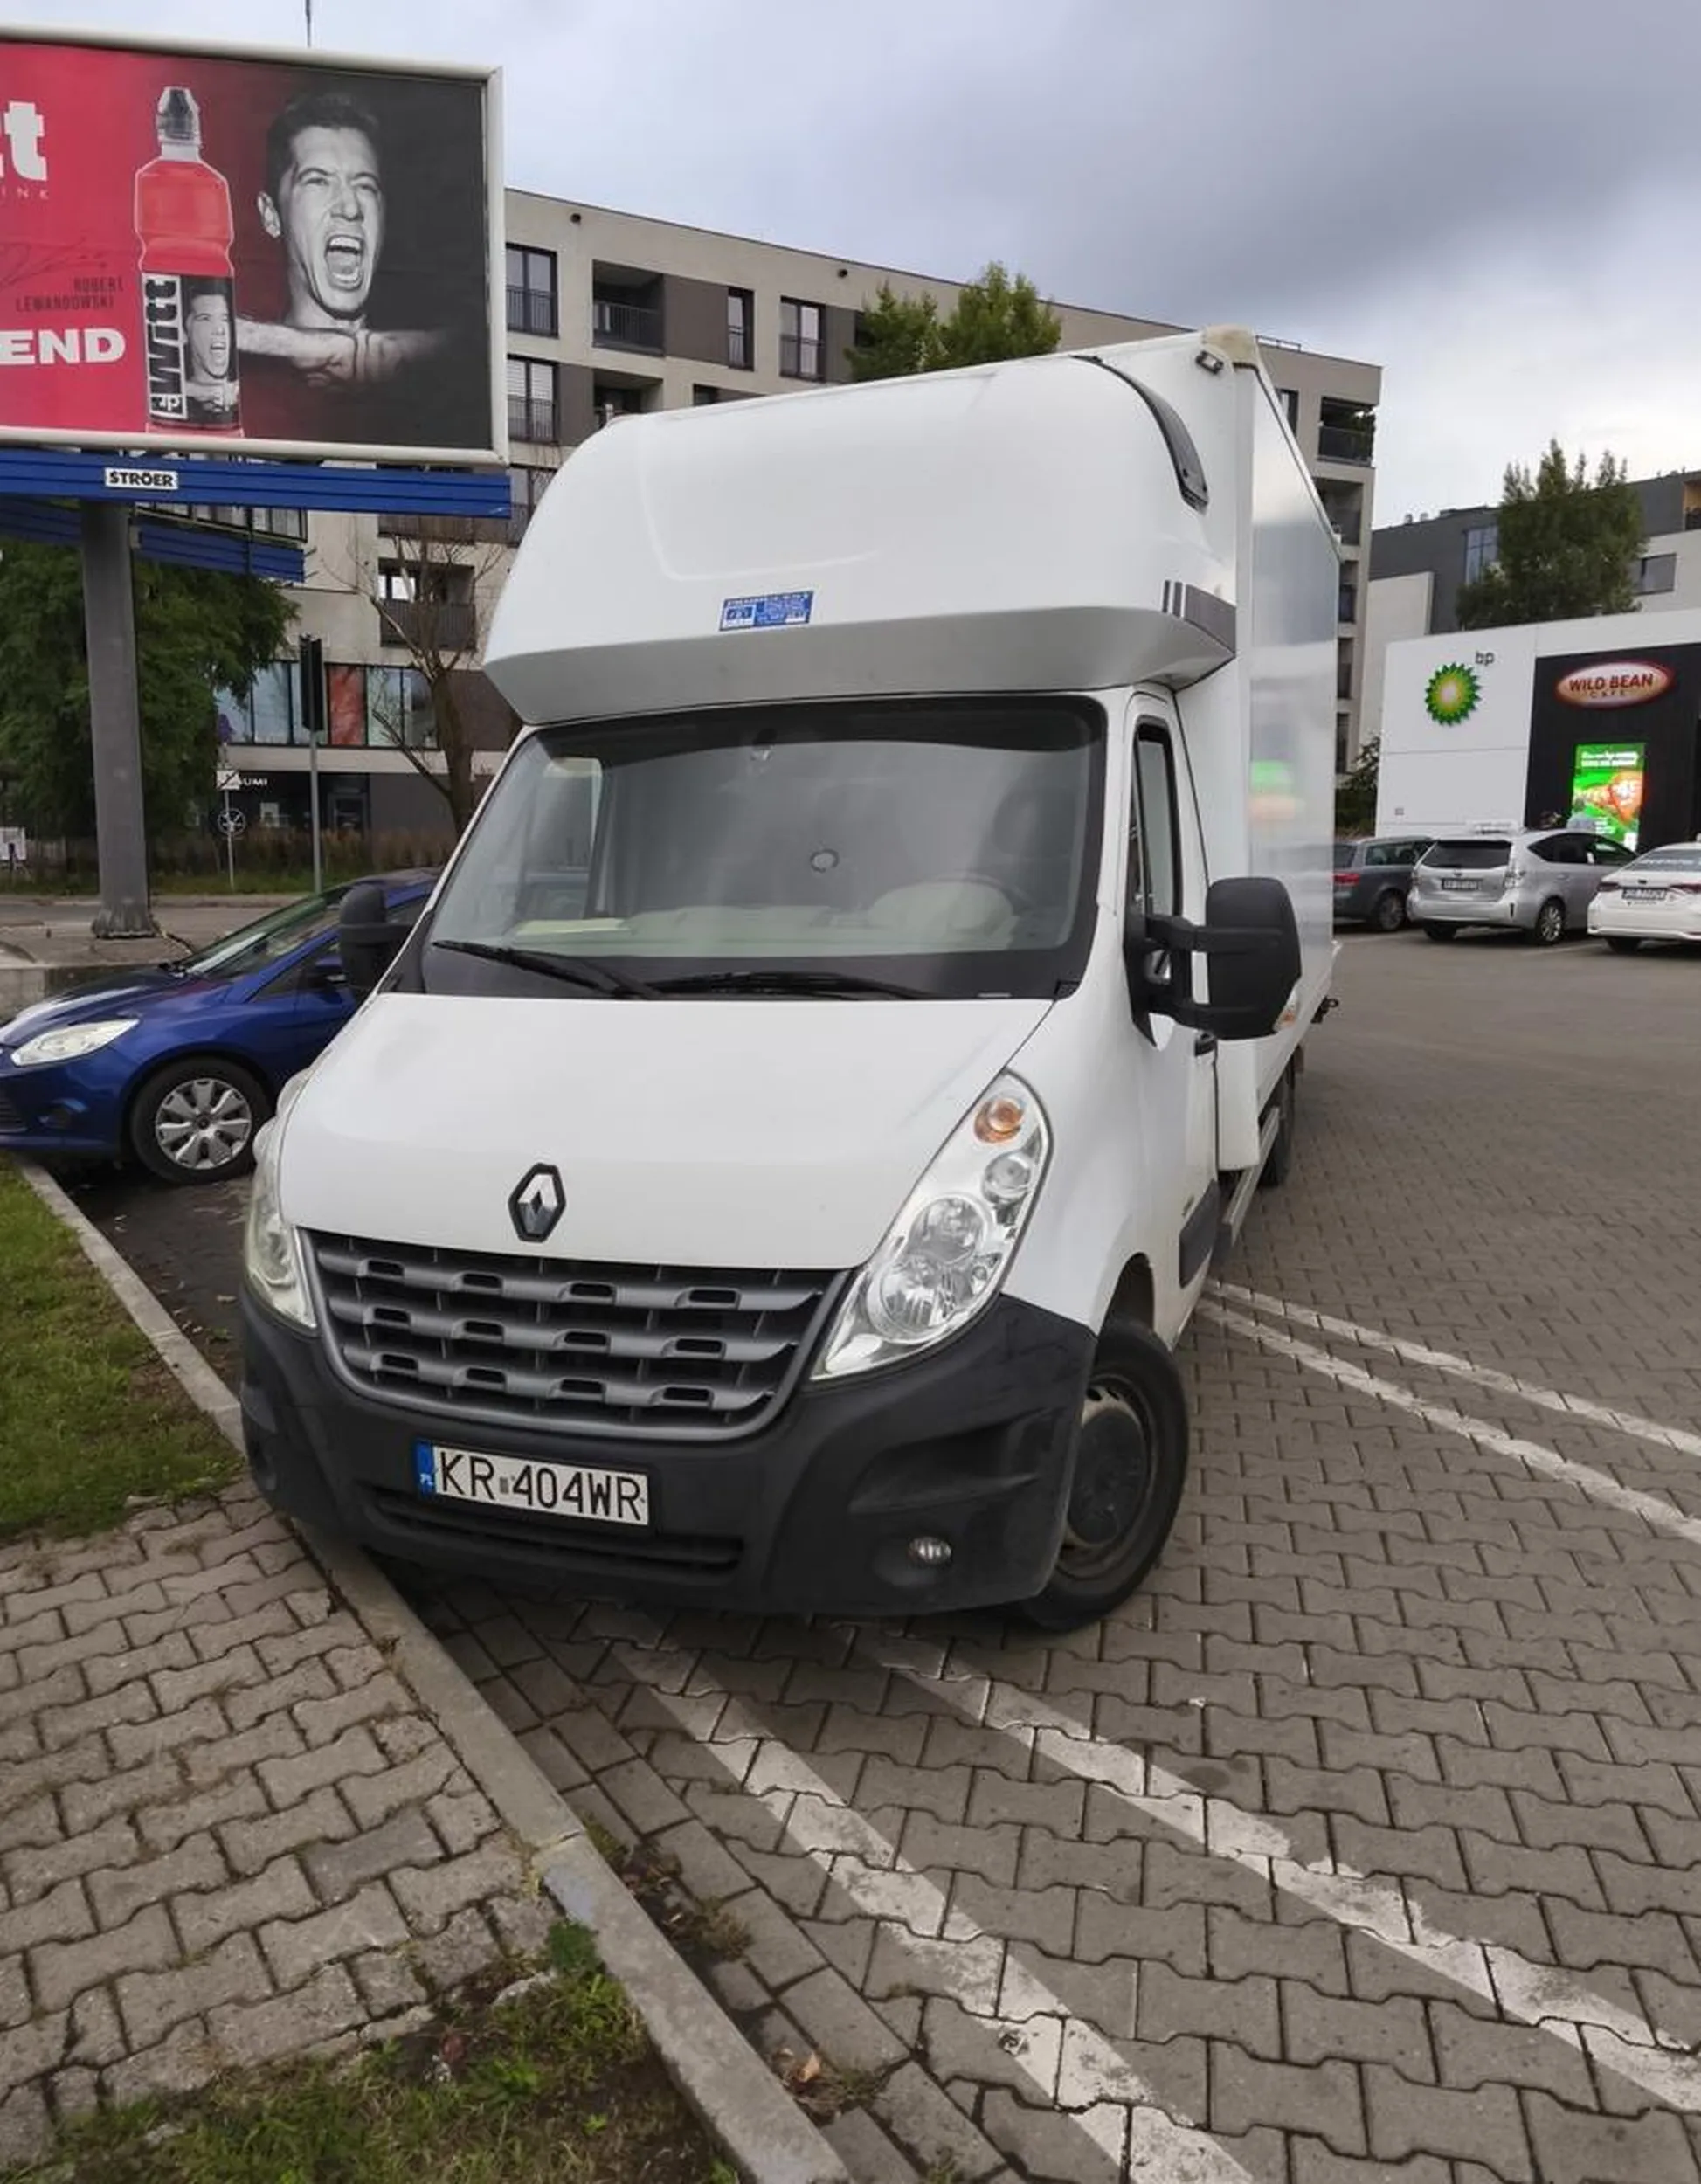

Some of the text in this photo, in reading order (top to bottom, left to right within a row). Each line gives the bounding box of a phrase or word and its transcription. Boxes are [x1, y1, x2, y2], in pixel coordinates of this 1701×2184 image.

[0, 100, 47, 181] t
[73, 275, 124, 292] ROBERT
[15, 294, 114, 312] LEWANDOWSKI
[110, 471, 174, 487] STRÖER
[1476, 651, 1495, 667] bp
[1569, 673, 1653, 691] WILD BEAN
[440, 1451, 641, 1520] KR 404WR
